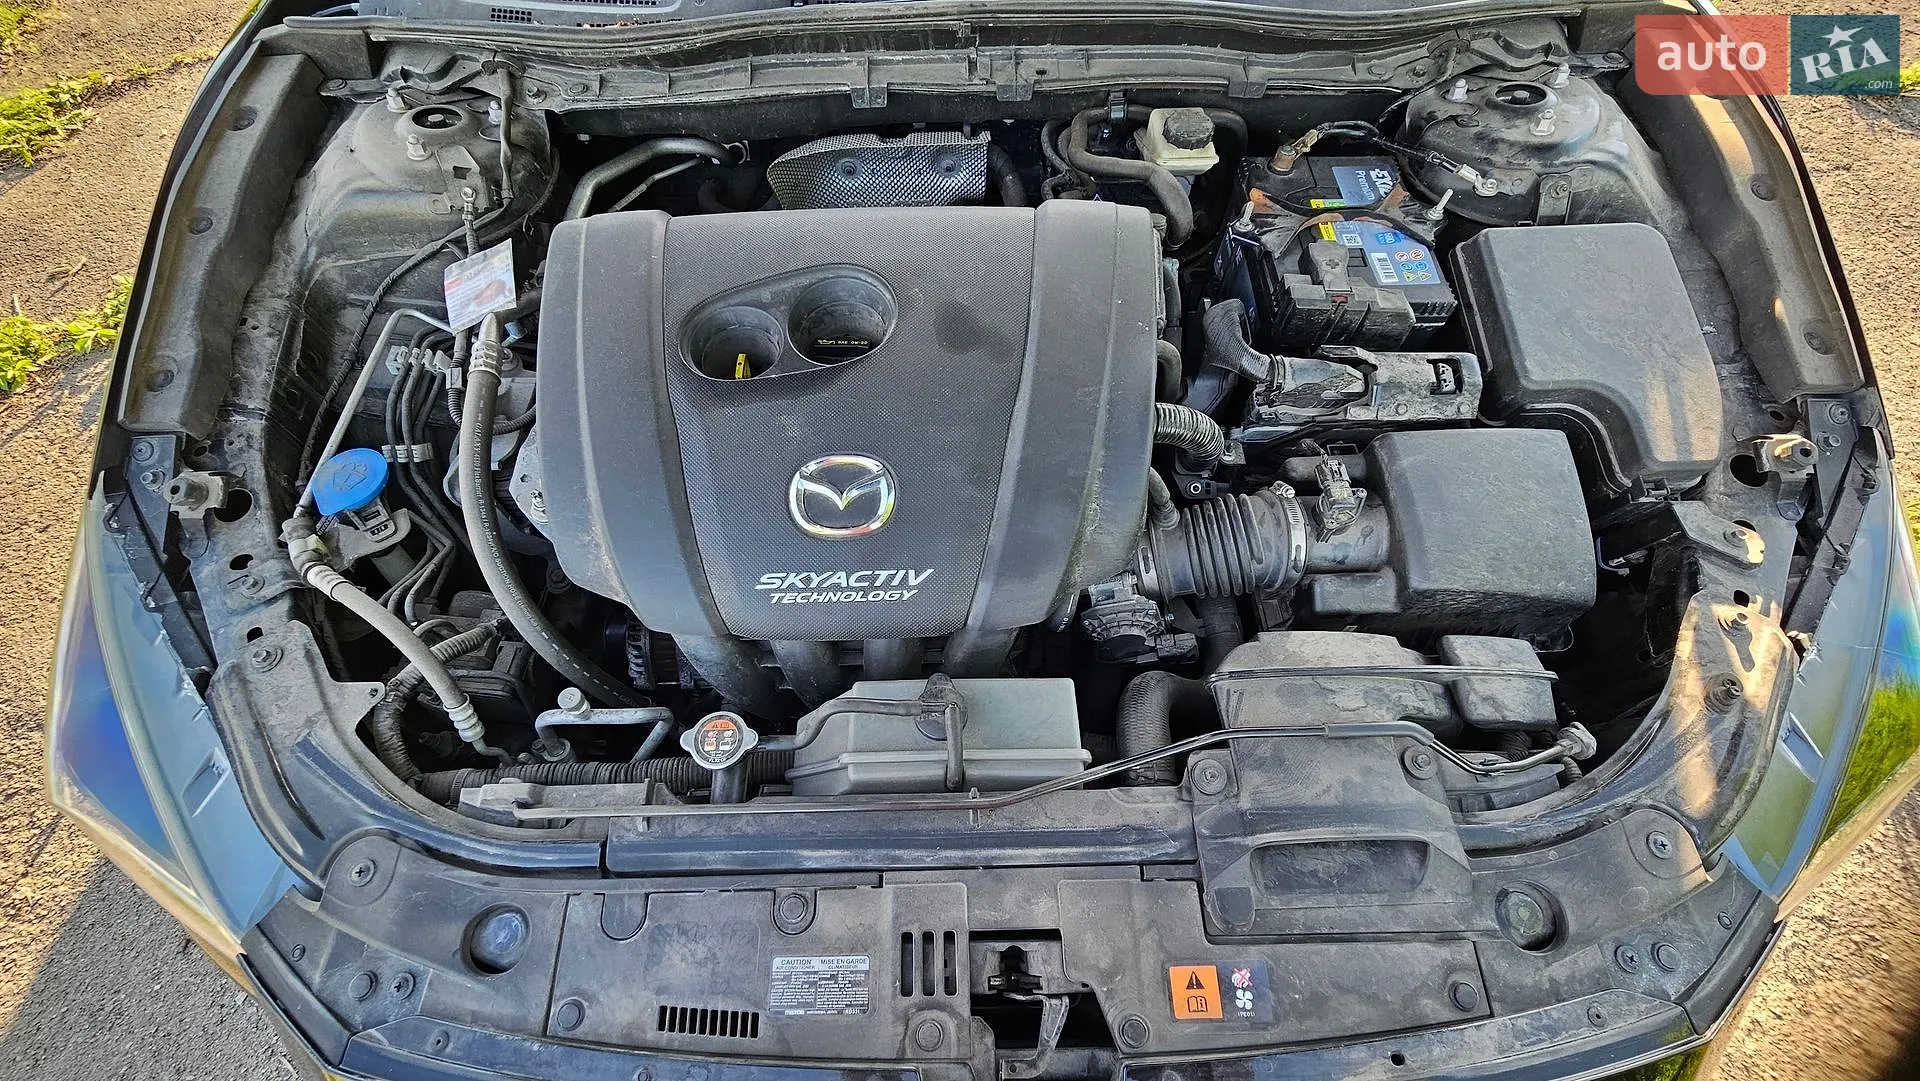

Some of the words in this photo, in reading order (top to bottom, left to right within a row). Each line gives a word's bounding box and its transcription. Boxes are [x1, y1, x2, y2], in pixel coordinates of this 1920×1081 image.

[1355, 170, 1376, 200] Premium
[754, 568, 935, 590] SKYACTIV
[770, 589, 920, 604] TECHNOLOGY
